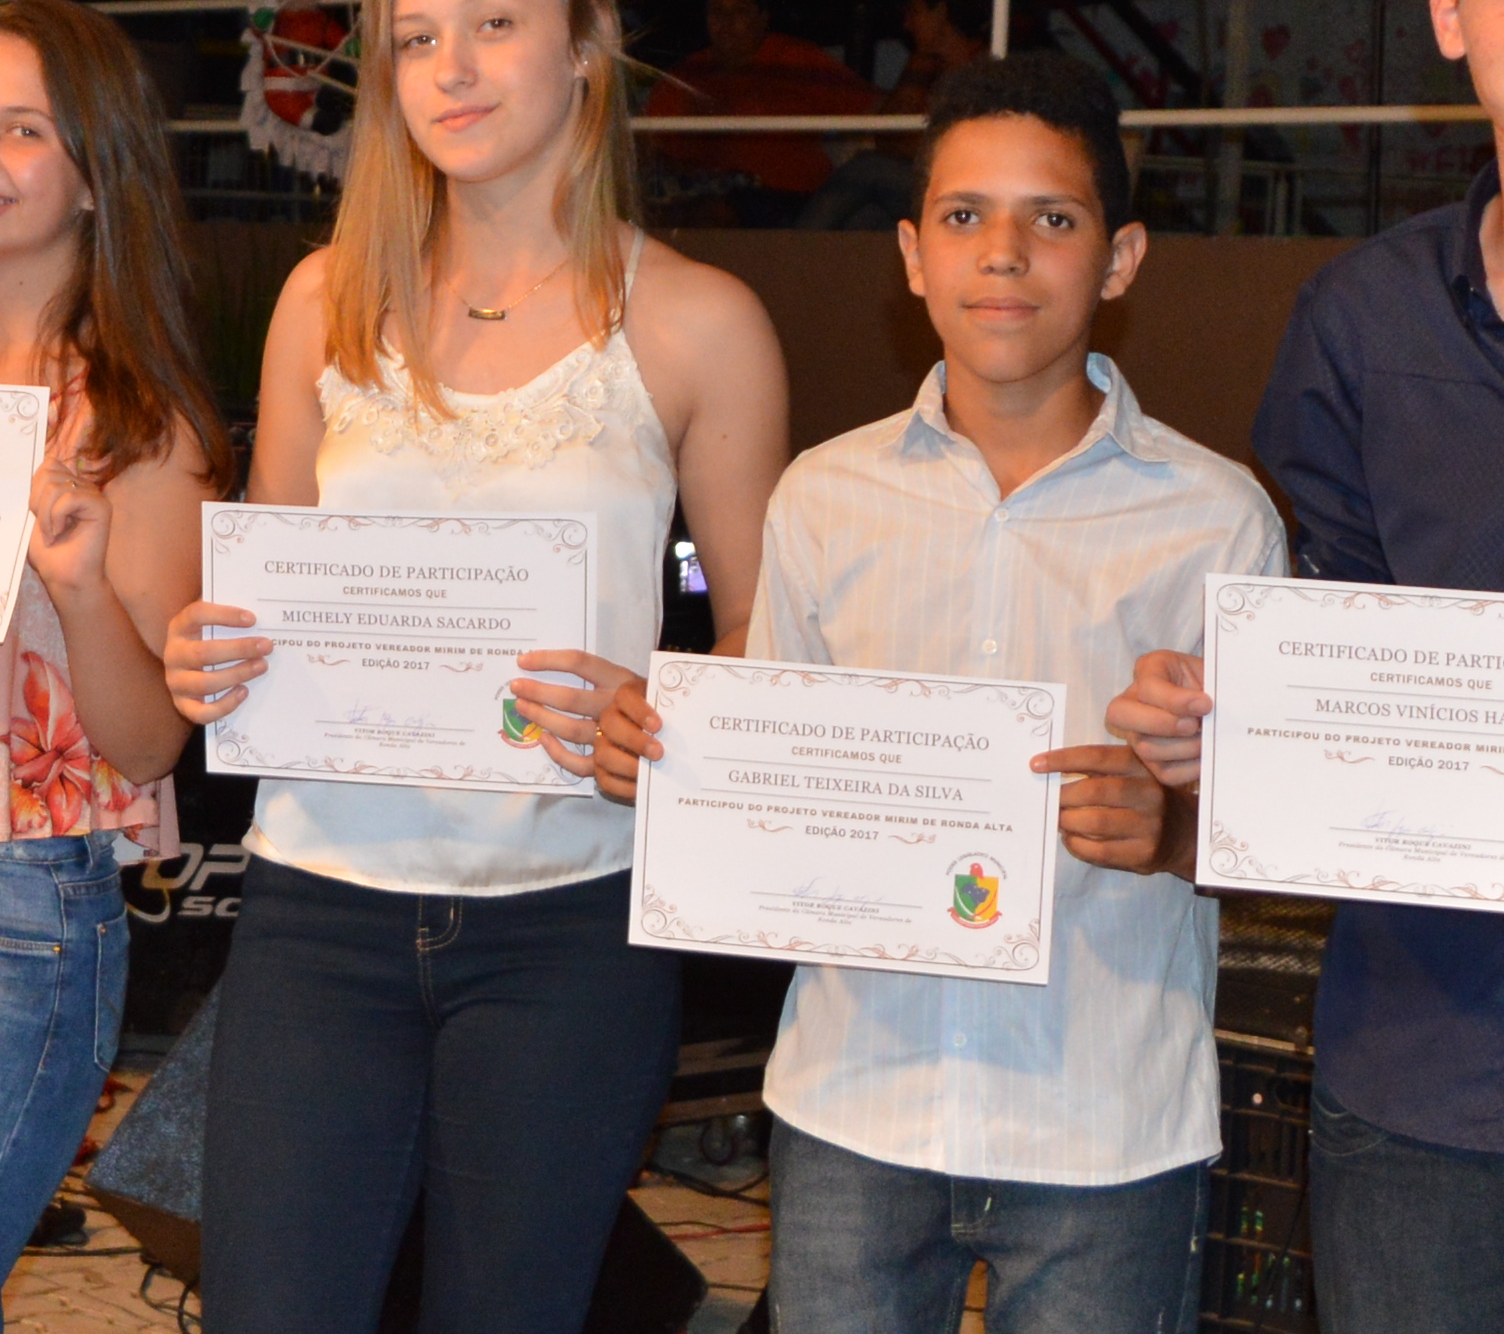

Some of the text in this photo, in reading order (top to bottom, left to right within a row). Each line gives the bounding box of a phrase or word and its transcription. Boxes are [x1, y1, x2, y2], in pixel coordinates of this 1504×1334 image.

[264, 560, 529, 584] CERTIFICADO DE PARTICIPAÇÃO
[342, 585, 447, 600] CERTIFICAMOS QUE
[282, 610, 511, 631] MICHELY EDUARDA SACARDO
[361, 657, 430, 671] EDIÇÃO 2017
[1278, 640, 1408, 663] CERTIFICADO
[1413, 649, 1440, 666] DE
[1370, 671, 1492, 691] CERTIFICAMOS QUE
[1315, 698, 1391, 717] MARCOS
[1396, 703, 1479, 723] VINÍCIOS
[709, 715, 990, 752] CERTIFICADO DE PARTICIPAÇÃO
[1247, 727, 1320, 741] PARTICIPOU
[1324, 733, 1341, 742] DO
[1345, 734, 1401, 747] PROJETO
[1405, 739, 1471, 752] VEREADOR
[791, 745, 902, 765] CERTIFICAMOS QUE
[1388, 755, 1470, 771] EDIÇÃO 2017
[728, 769, 963, 802] GABRIEL TEIXEIRA DA SILVA
[677, 797, 1013, 833] PARTICIPOU DO PROJETO VEREADOR MIRIM DE RONDA ALTA
[805, 825, 879, 841] EDIÇÃO 2017
